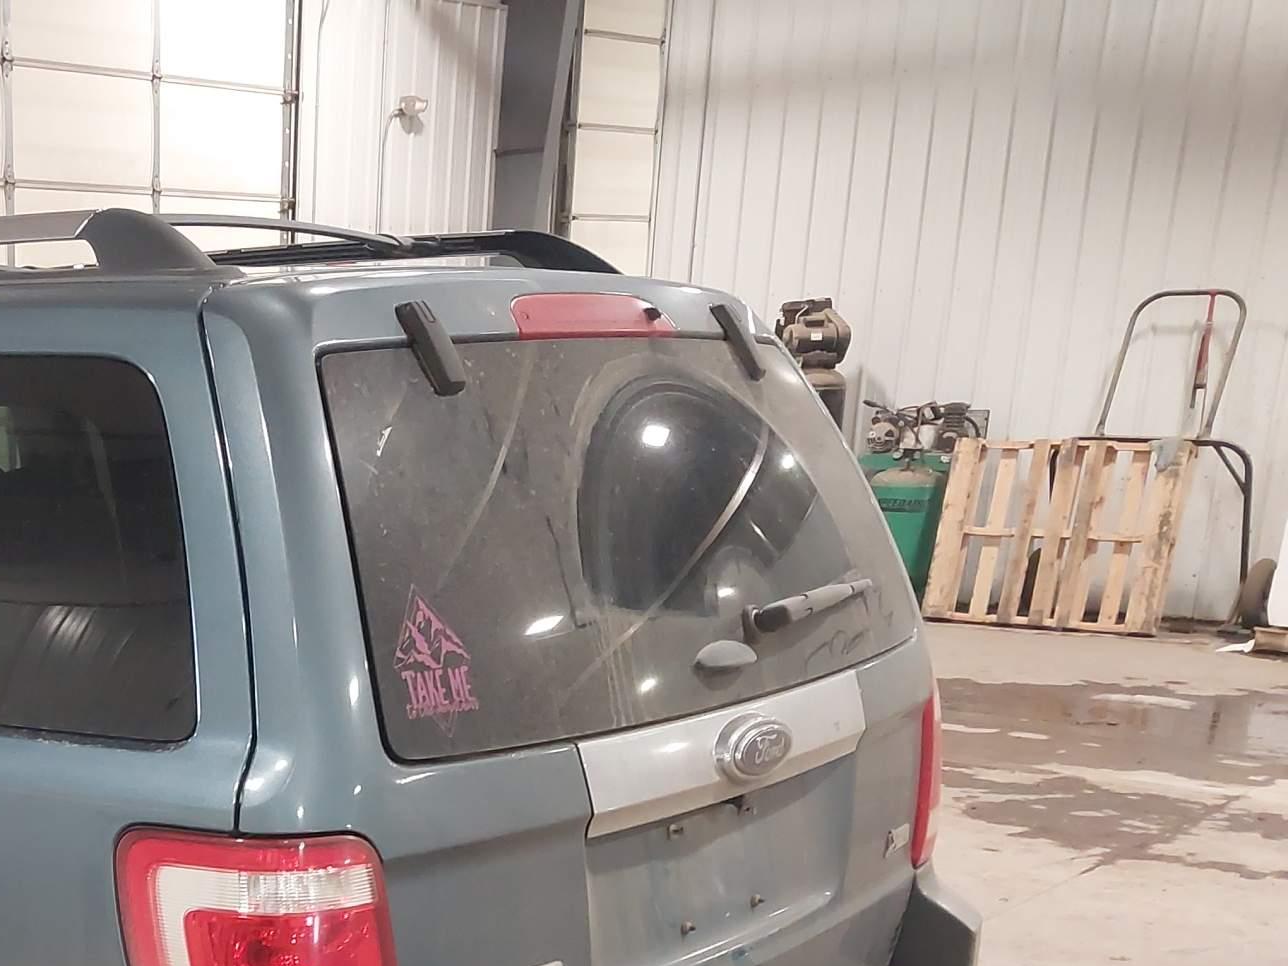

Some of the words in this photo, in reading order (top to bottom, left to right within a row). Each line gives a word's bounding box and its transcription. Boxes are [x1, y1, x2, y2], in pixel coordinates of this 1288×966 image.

[401, 668, 449, 706] TAKE
[447, 665, 476, 703] ME
[754, 732, 786, 765] Ford
